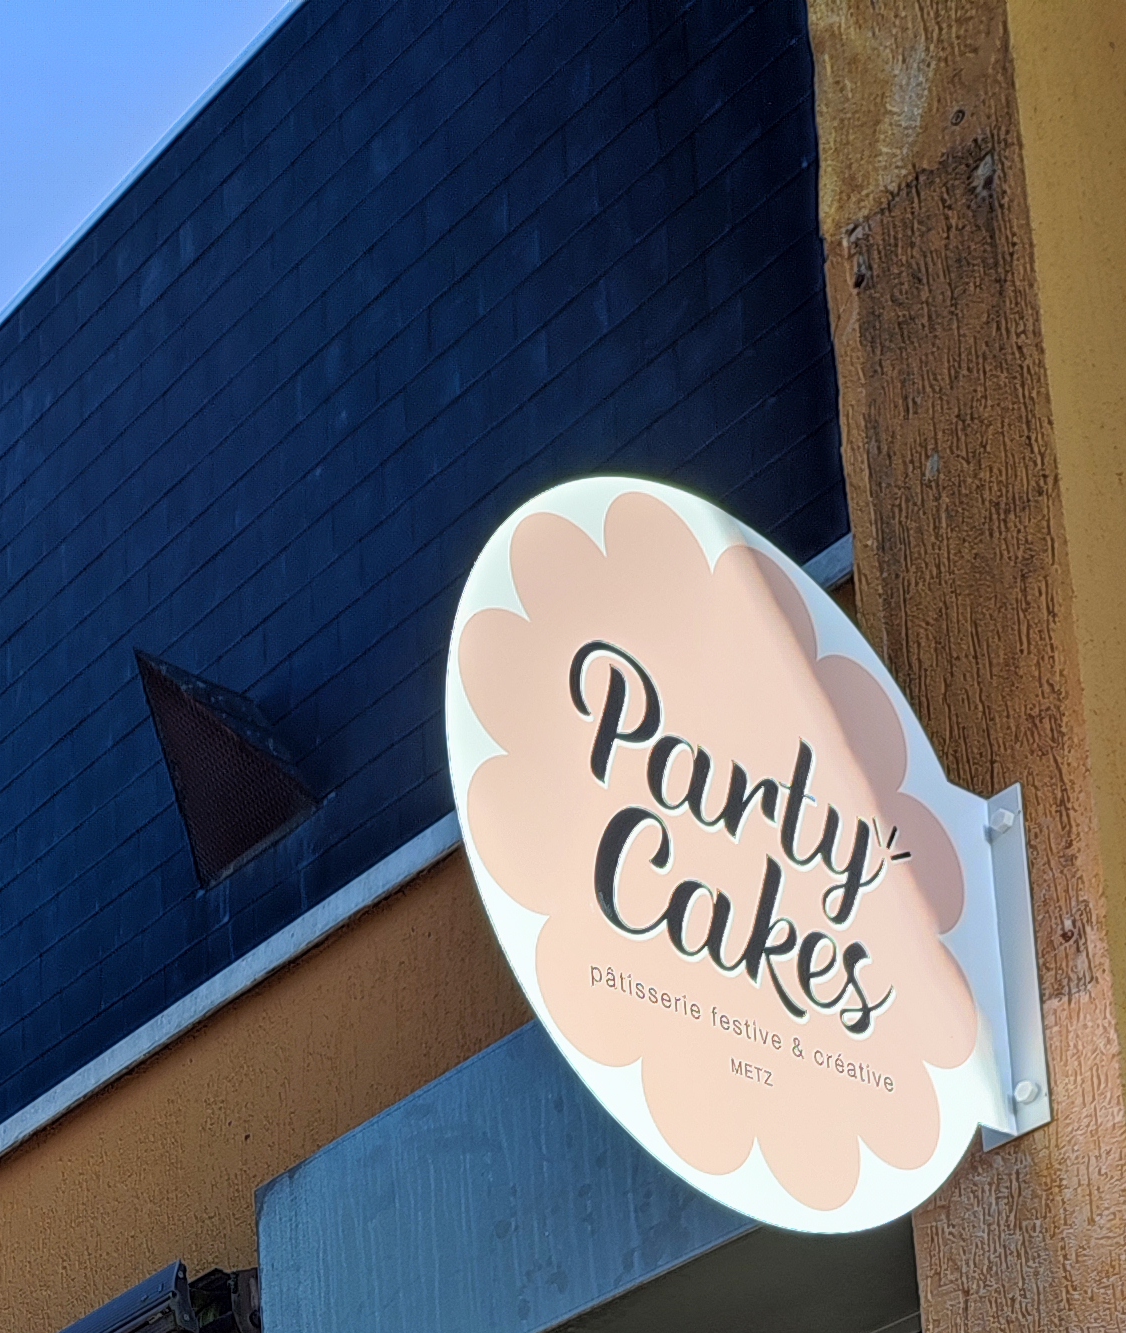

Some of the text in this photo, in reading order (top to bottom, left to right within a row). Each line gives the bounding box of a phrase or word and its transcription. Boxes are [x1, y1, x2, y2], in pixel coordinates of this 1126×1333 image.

[568, 639, 887, 925] Party
[594, 805, 894, 1034] Cakes
[590, 965, 895, 1093] pâtisserie festive & créative
[730, 1057, 775, 1088] METZ
